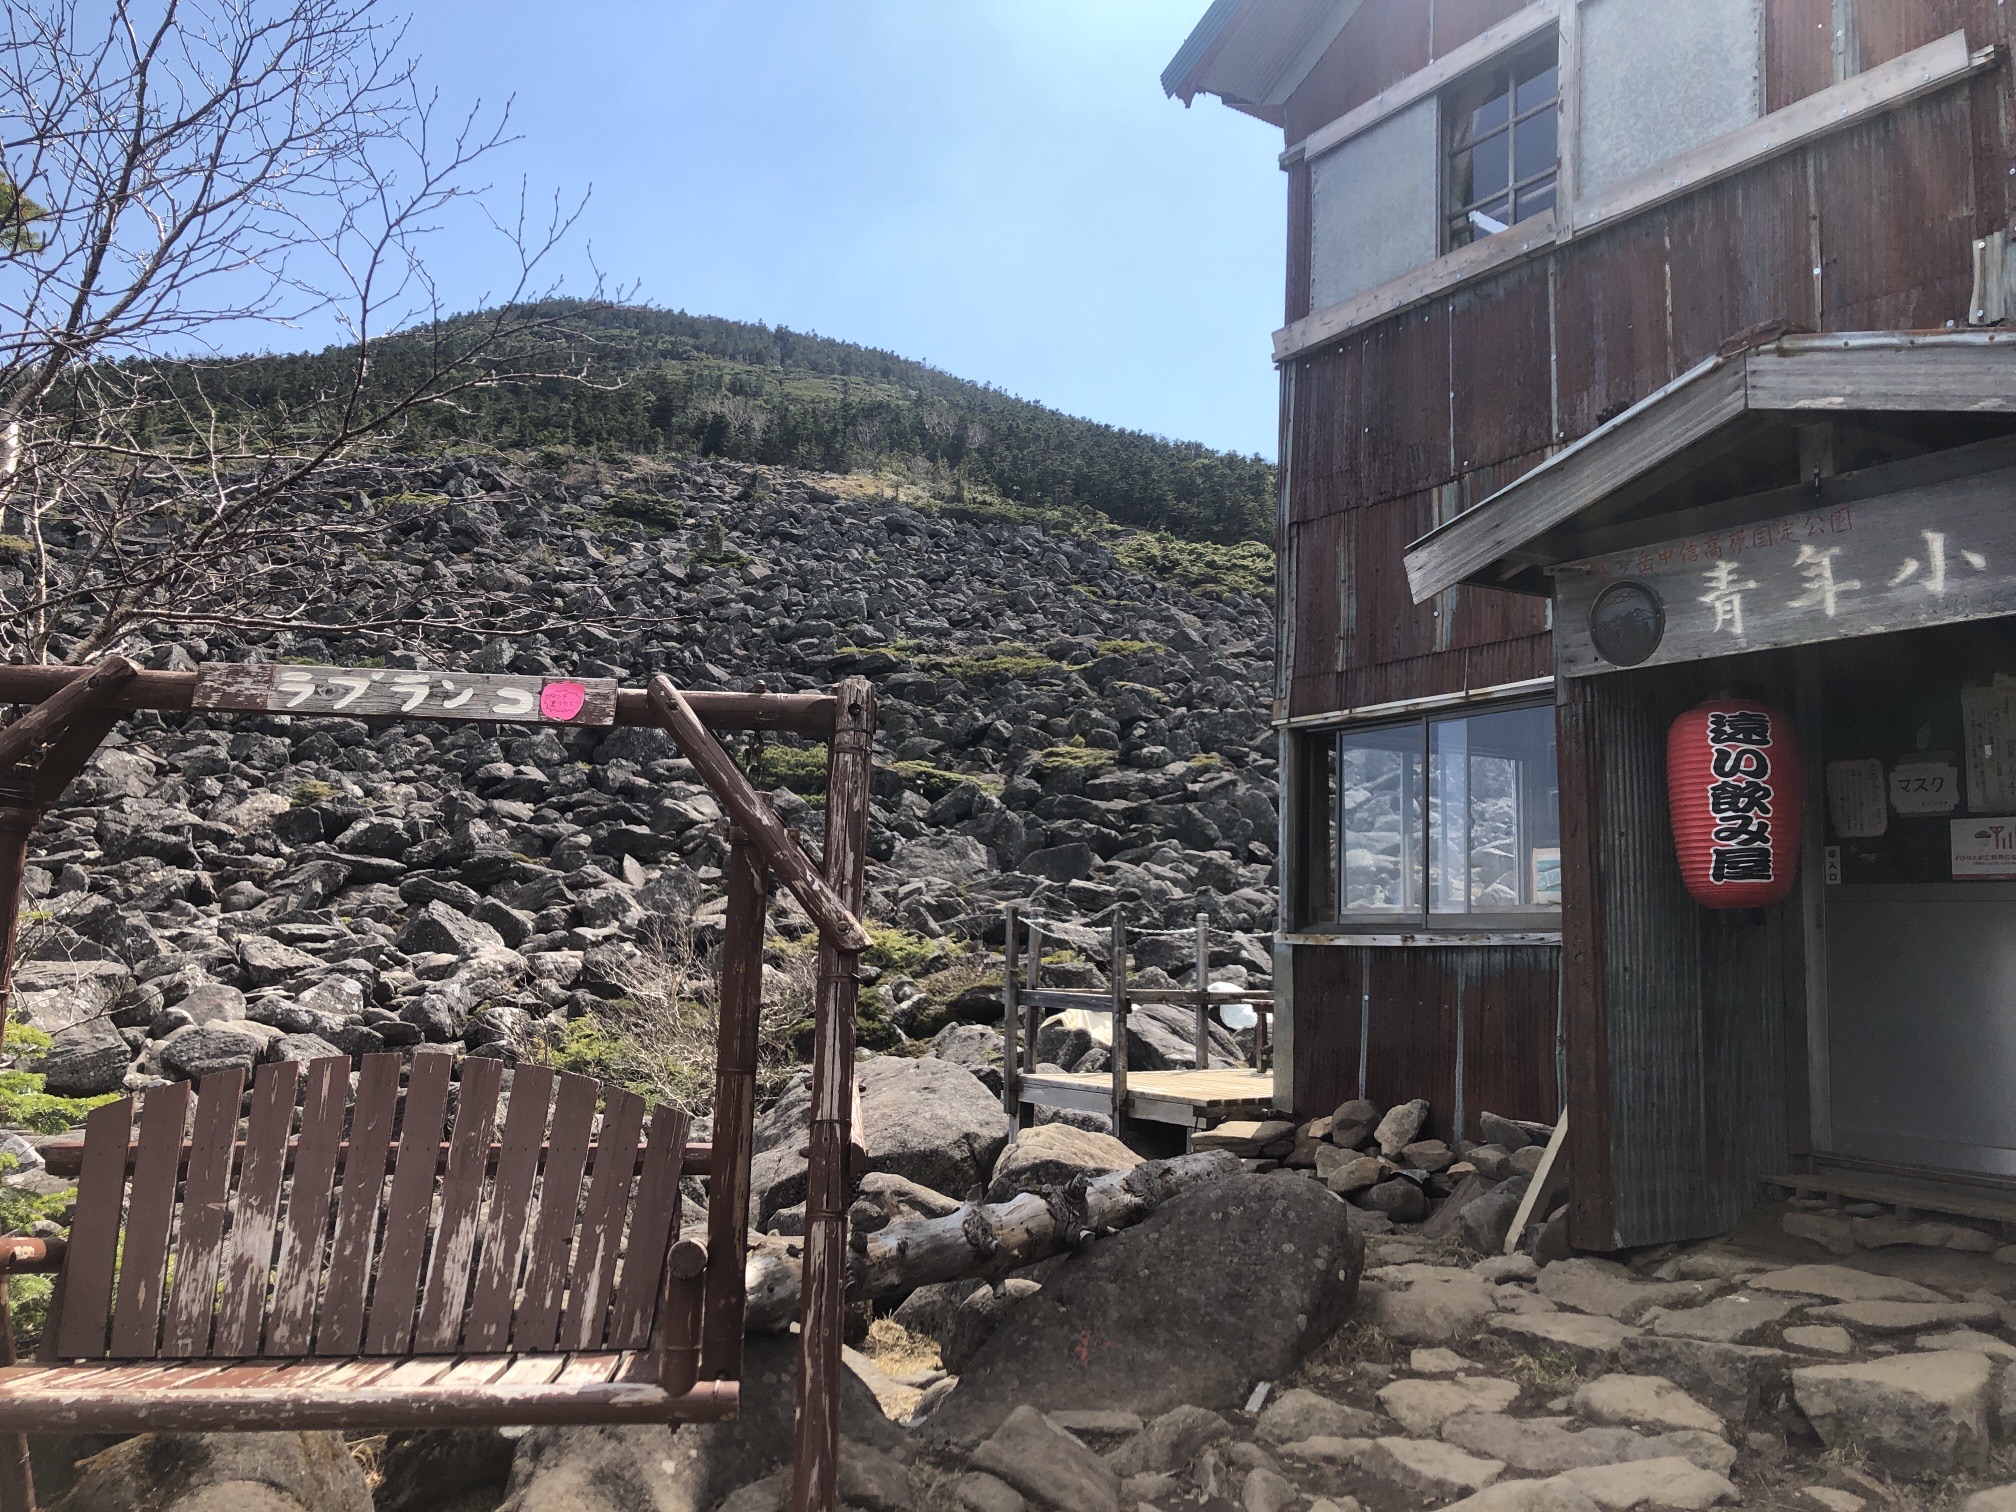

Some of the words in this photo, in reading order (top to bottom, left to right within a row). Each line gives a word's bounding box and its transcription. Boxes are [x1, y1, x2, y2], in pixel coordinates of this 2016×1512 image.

[1706, 710, 1774, 884] 遠い飲み屋
[1898, 777, 1945, 794] マスク
